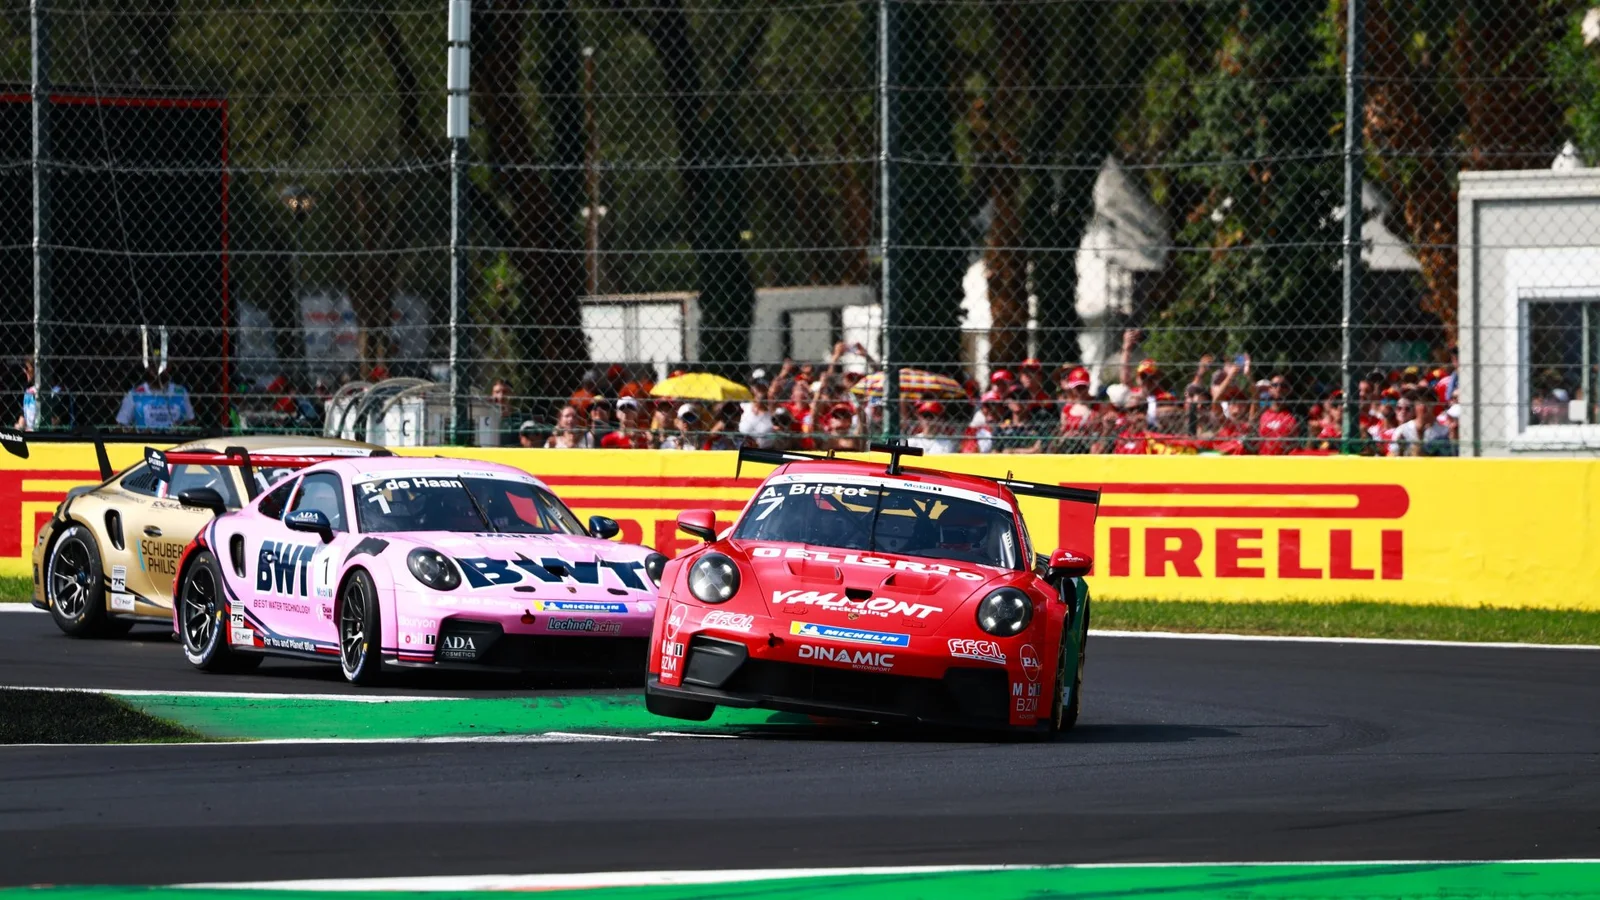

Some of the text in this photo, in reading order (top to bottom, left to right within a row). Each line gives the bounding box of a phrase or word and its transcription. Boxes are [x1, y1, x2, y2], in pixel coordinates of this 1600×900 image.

[361, 478, 463, 494] R. de Haan
[759, 484, 869, 499] A. Bristot
[756, 496, 785, 520] 7
[1059, 483, 1409, 580] PIRELLI
[141, 540, 188, 559] SCHUBER
[148, 557, 176, 575] PHILIS
[257, 540, 317, 597] BWT
[323, 557, 329, 585] 1
[752, 547, 984, 581] DELLORTO
[454, 556, 647, 591] BWT
[254, 600, 268, 609] BEST
[269, 602, 282, 611] WATER
[282, 603, 311, 615] TECHNOLOGY
[772, 590, 943, 619] VALMONT
[822, 605, 888, 617] Packaging
[263, 637, 271, 645] For
[272, 637, 280, 647] You
[280, 639, 289, 648] and
[441, 636, 476, 650] ADA
[824, 629, 900, 642] MICHELIN
[798, 644, 896, 667] DINAMIC
[852, 663, 892, 673] MOTORSPORT
[1016, 698, 1038, 712] BZM
